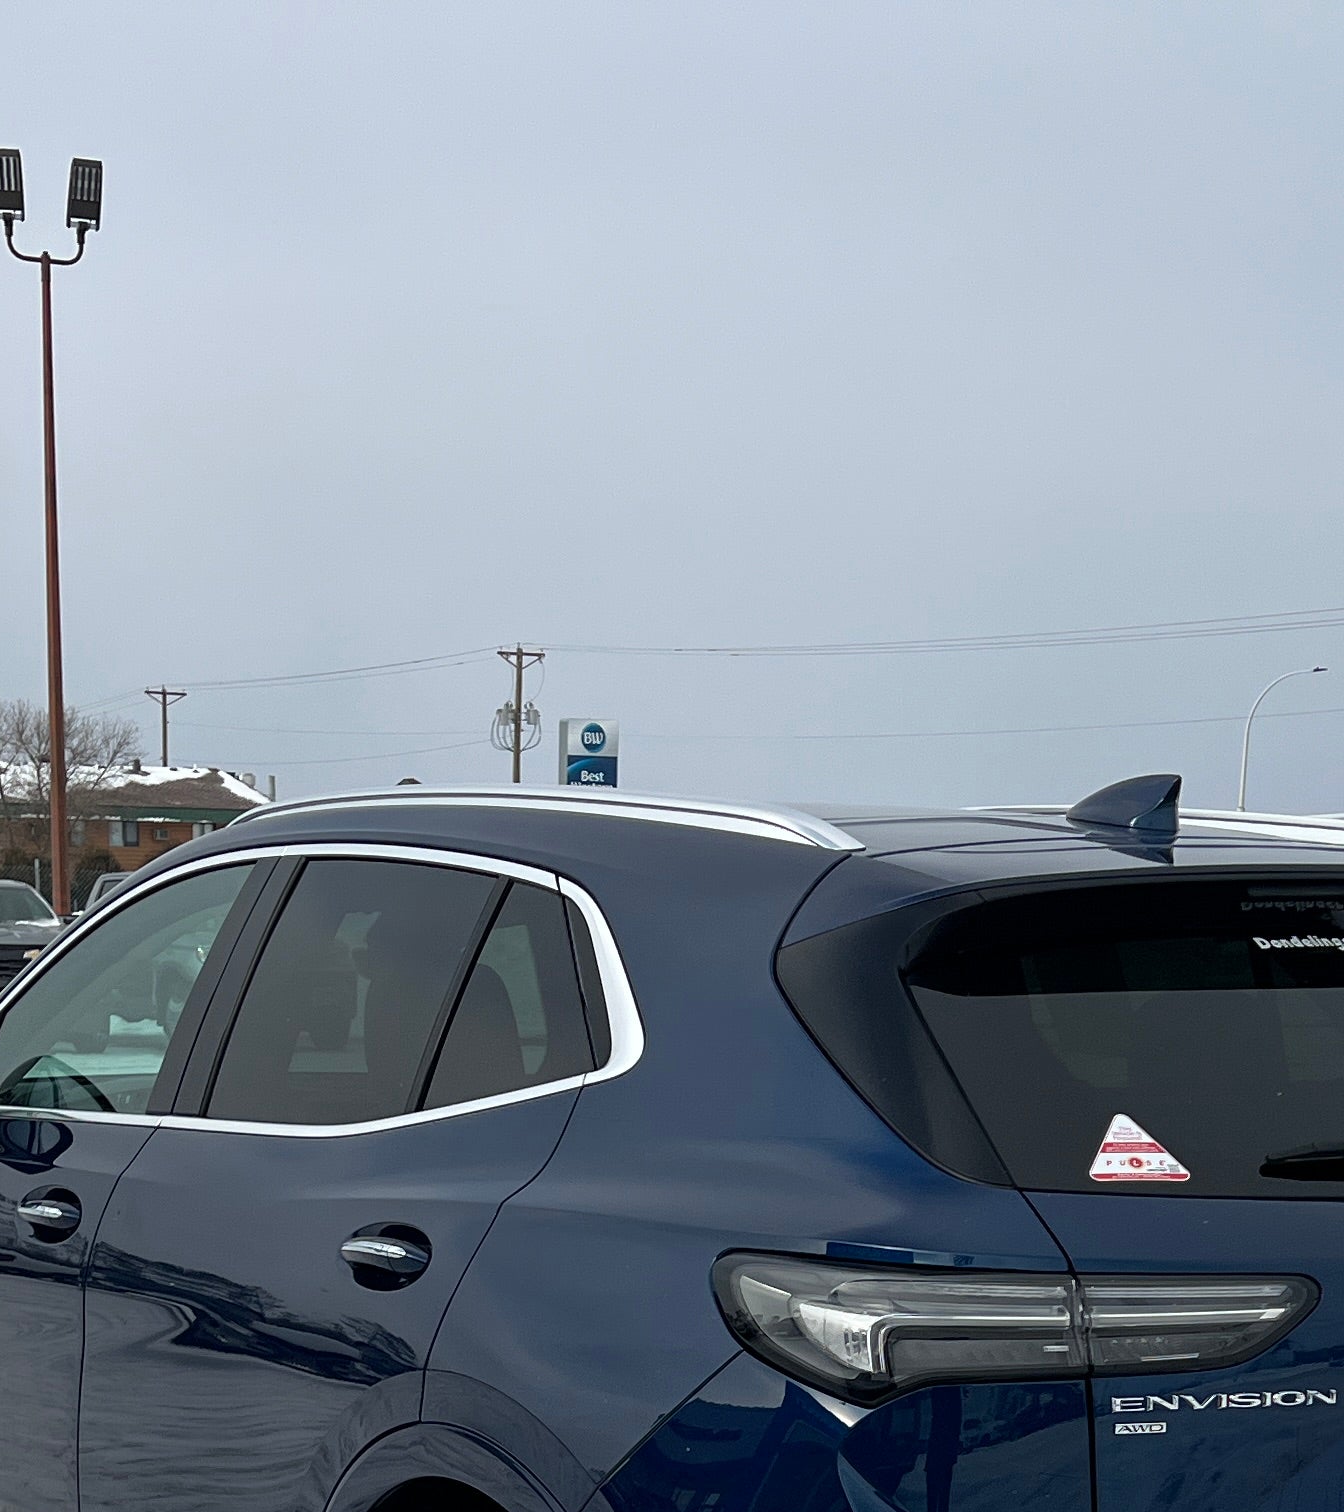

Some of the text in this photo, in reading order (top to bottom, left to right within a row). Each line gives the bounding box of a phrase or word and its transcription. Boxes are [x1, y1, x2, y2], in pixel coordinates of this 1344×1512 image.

[583, 732, 604, 745] BW
[581, 770, 605, 782] Best
[1111, 1389, 1337, 1413] ENVISION
[1116, 1422, 1166, 1434] AWD
